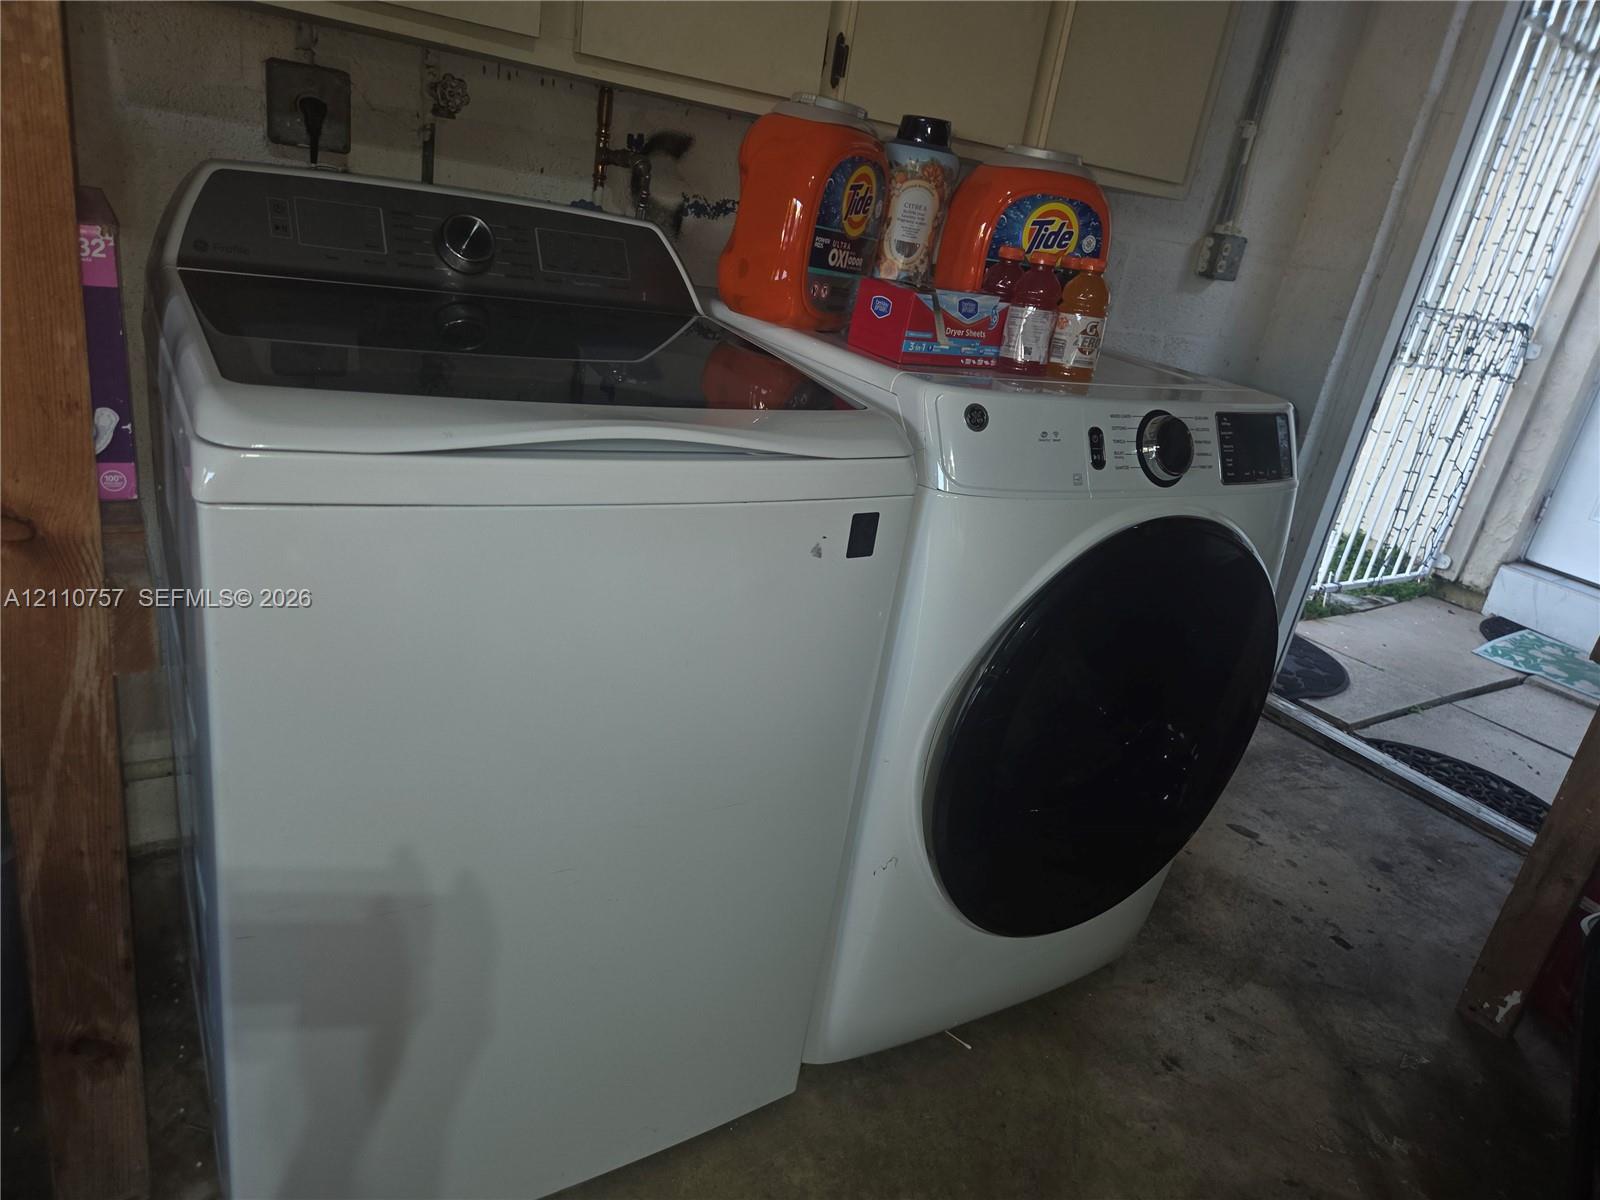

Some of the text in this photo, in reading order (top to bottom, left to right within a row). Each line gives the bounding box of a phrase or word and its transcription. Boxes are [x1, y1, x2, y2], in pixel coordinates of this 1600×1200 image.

[844, 183, 873, 221] Tide
[1025, 219, 1074, 254] Tide
[828, 248, 849, 269] OXI
[945, 327, 965, 340] Dryer
[965, 329, 986, 339] Sheets
